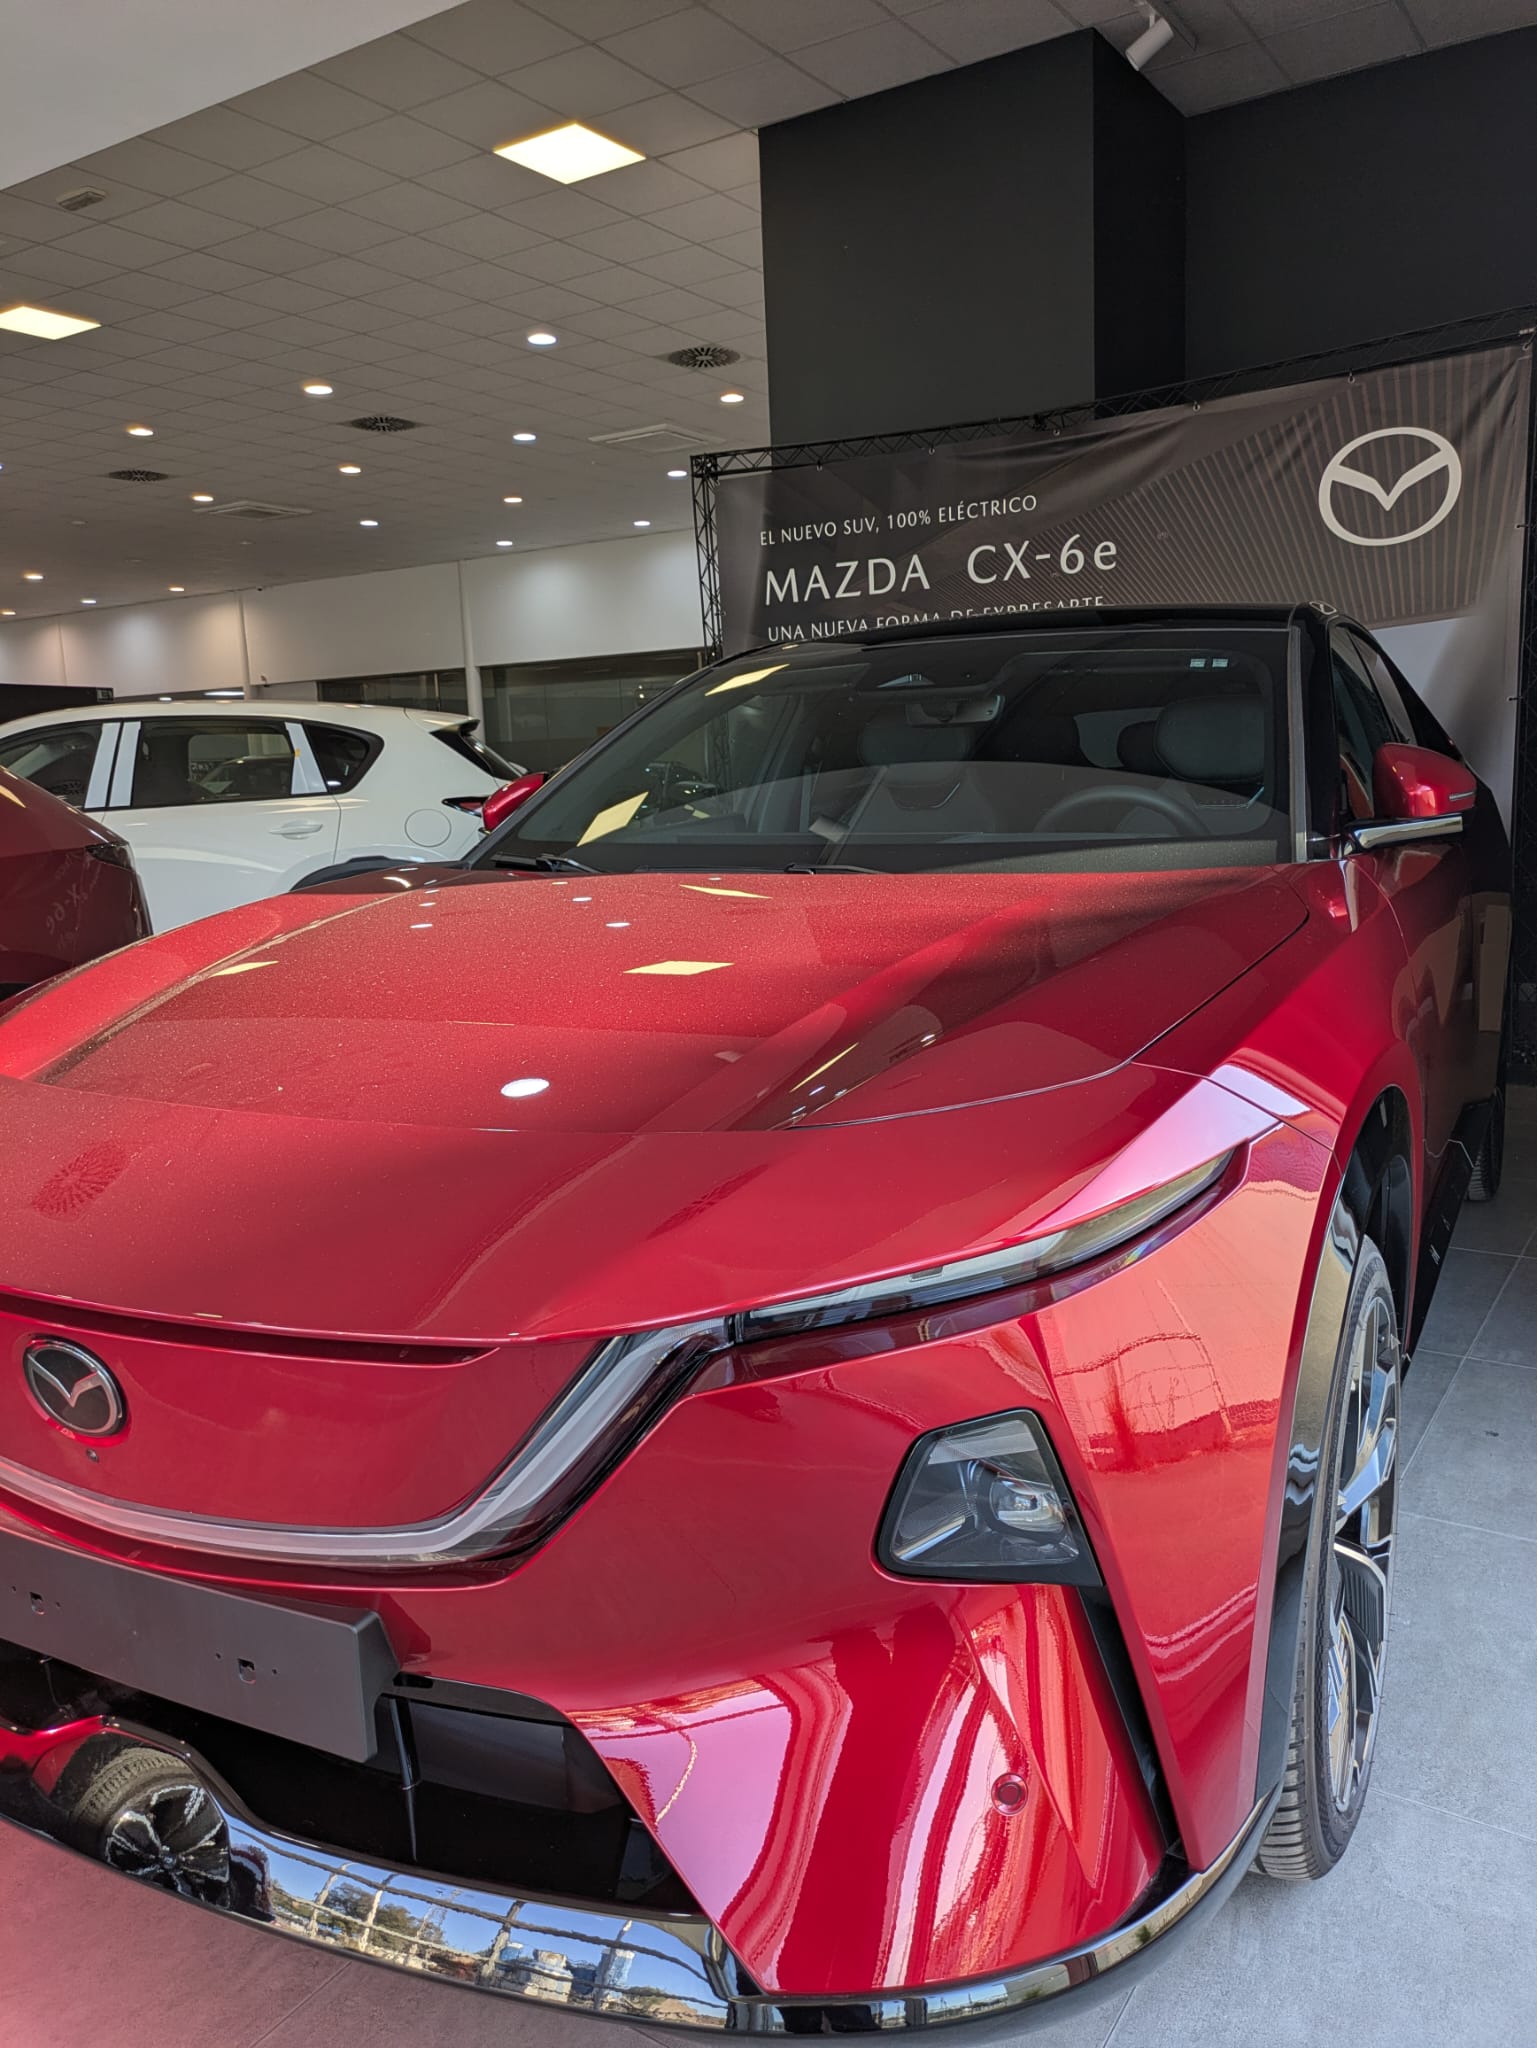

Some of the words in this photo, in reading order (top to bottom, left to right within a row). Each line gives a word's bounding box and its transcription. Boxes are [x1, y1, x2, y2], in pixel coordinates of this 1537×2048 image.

[760, 530, 776, 546] EL
[781, 521, 837, 543] NUEVO
[843, 515, 880, 536] SUV,
[887, 509, 931, 530] 100%
[938, 494, 1037, 523] ELÉCTRICO
[765, 553, 931, 606] MAZDA
[967, 533, 1117, 584] CX-6e
[768, 624, 805, 642] UNA
[811, 618, 868, 640] NUEVA
